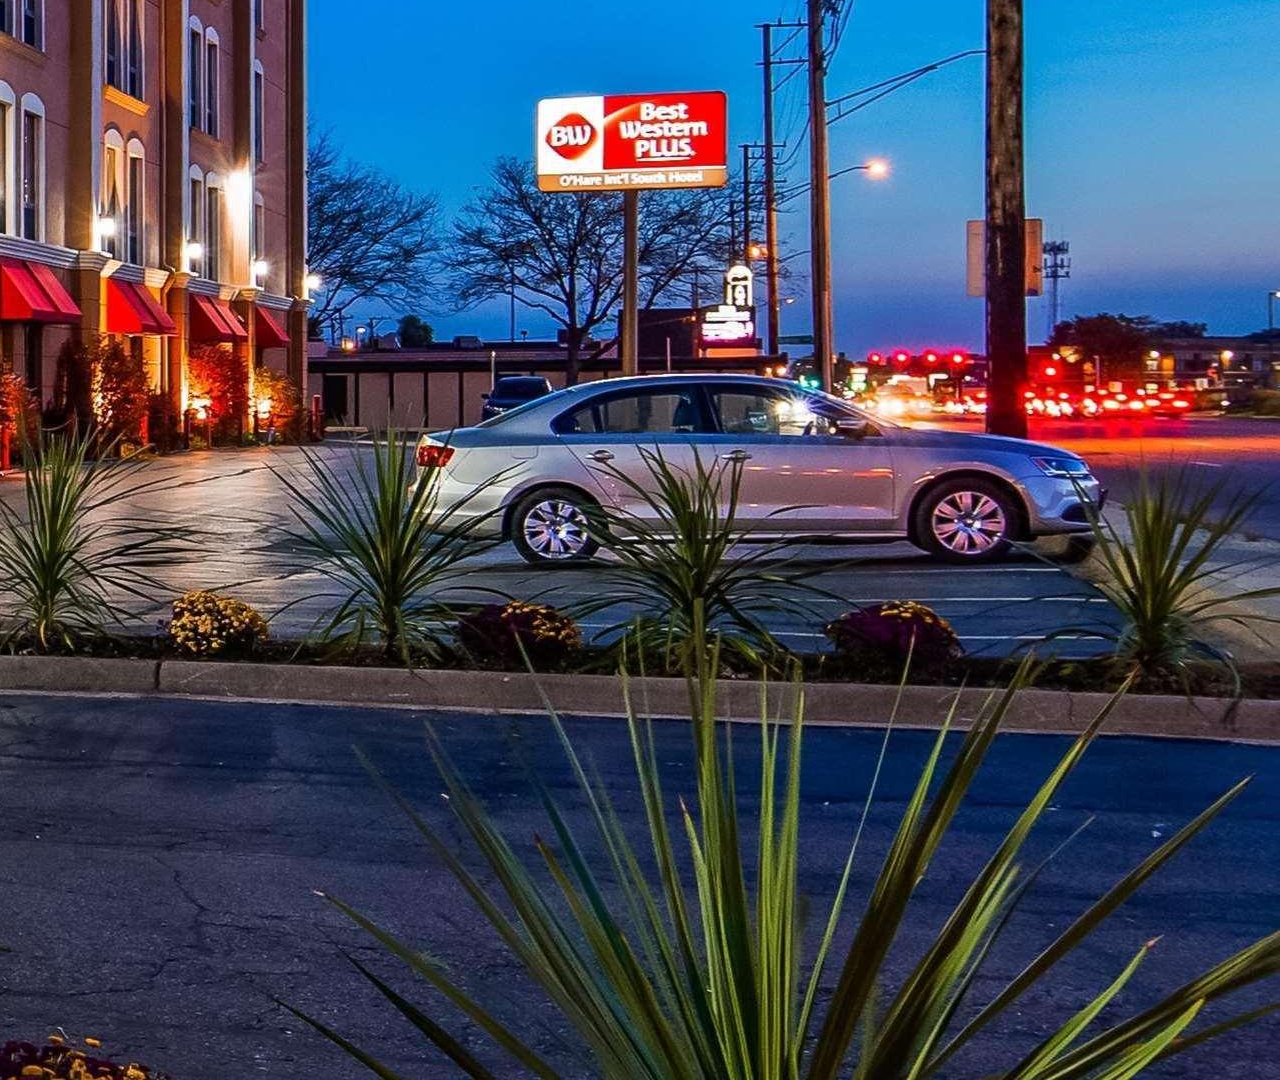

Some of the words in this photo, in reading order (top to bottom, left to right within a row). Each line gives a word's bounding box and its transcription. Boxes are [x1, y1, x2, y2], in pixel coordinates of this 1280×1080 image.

[640, 102, 689, 121] Best
[551, 125, 591, 146] BW
[619, 120, 708, 139] Western
[560, 175, 602, 187] O'Hare
